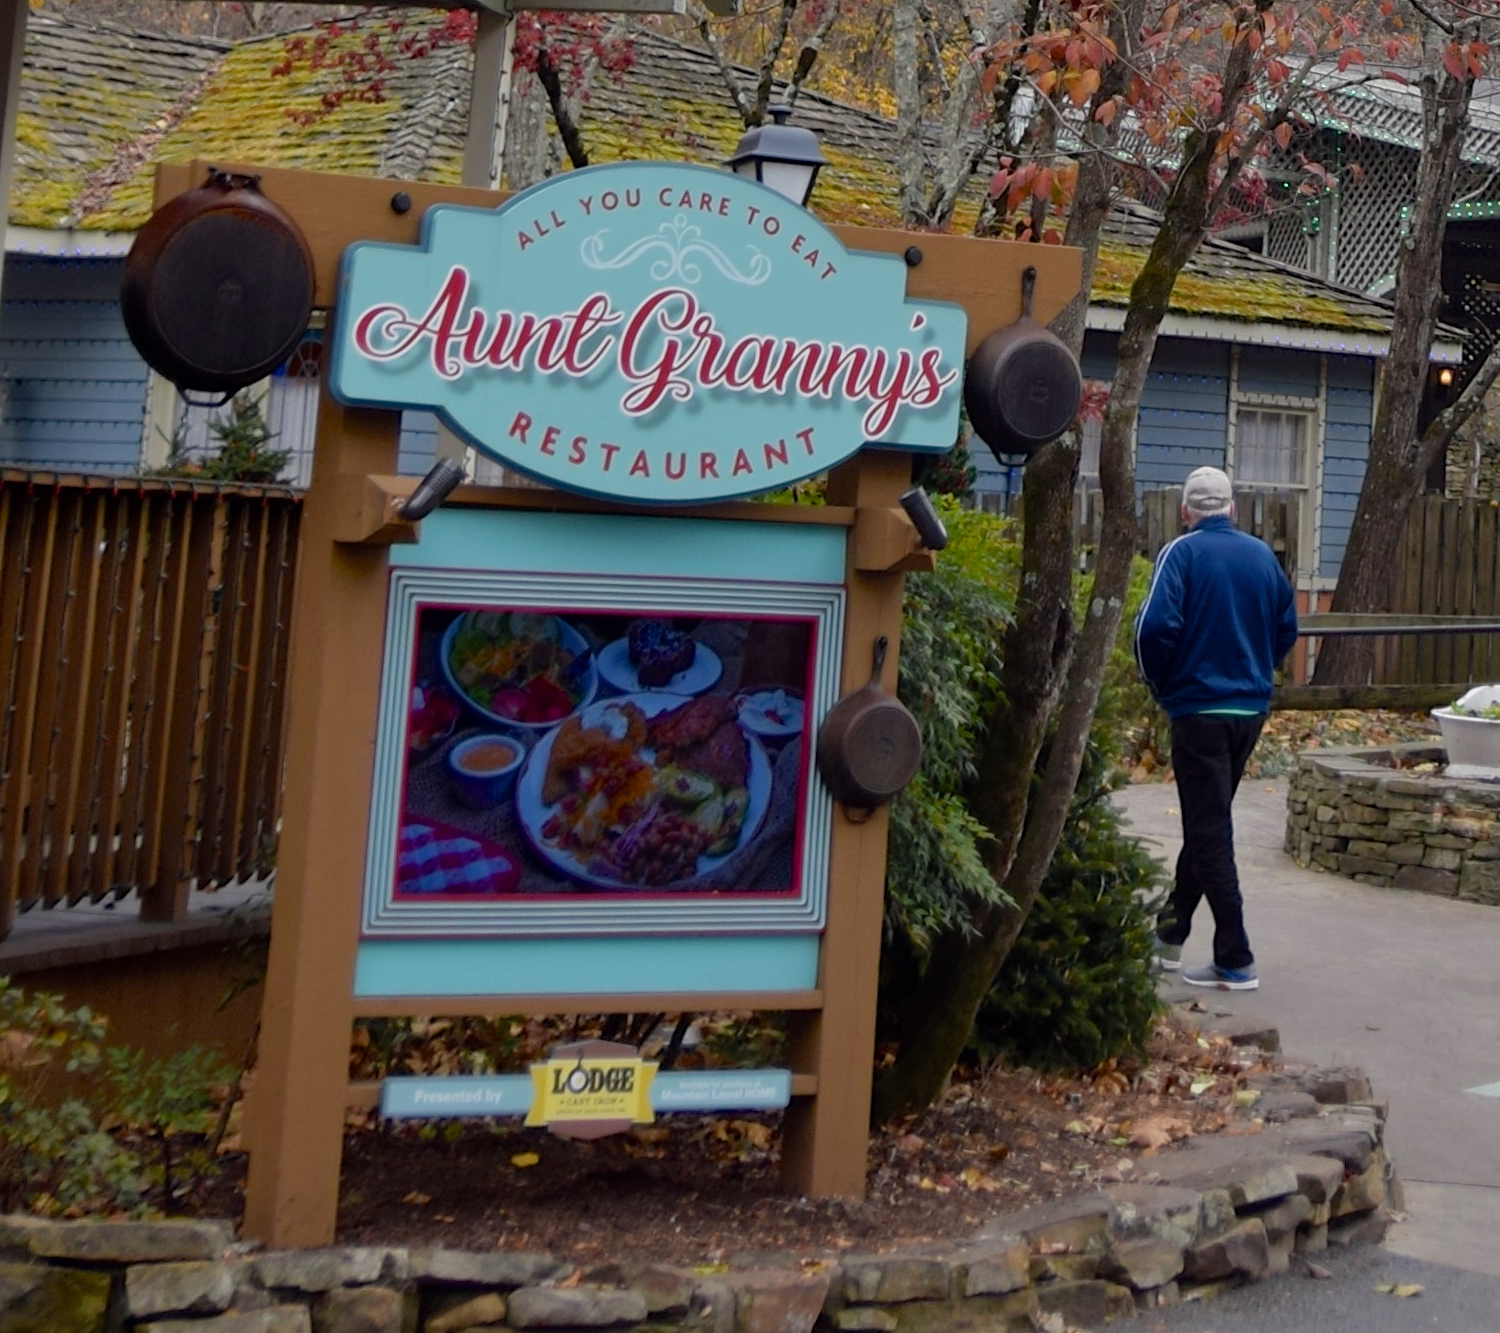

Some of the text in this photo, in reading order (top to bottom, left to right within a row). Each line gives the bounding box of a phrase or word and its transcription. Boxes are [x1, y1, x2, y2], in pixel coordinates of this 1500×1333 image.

[517, 185, 838, 283] ALL YOU CARE TO EAT
[355, 265, 958, 440] Aunt Granny's
[508, 410, 817, 481] RESTAURANT
[413, 1088, 503, 1106] Presented by
[552, 1066, 635, 1095] LODGE
